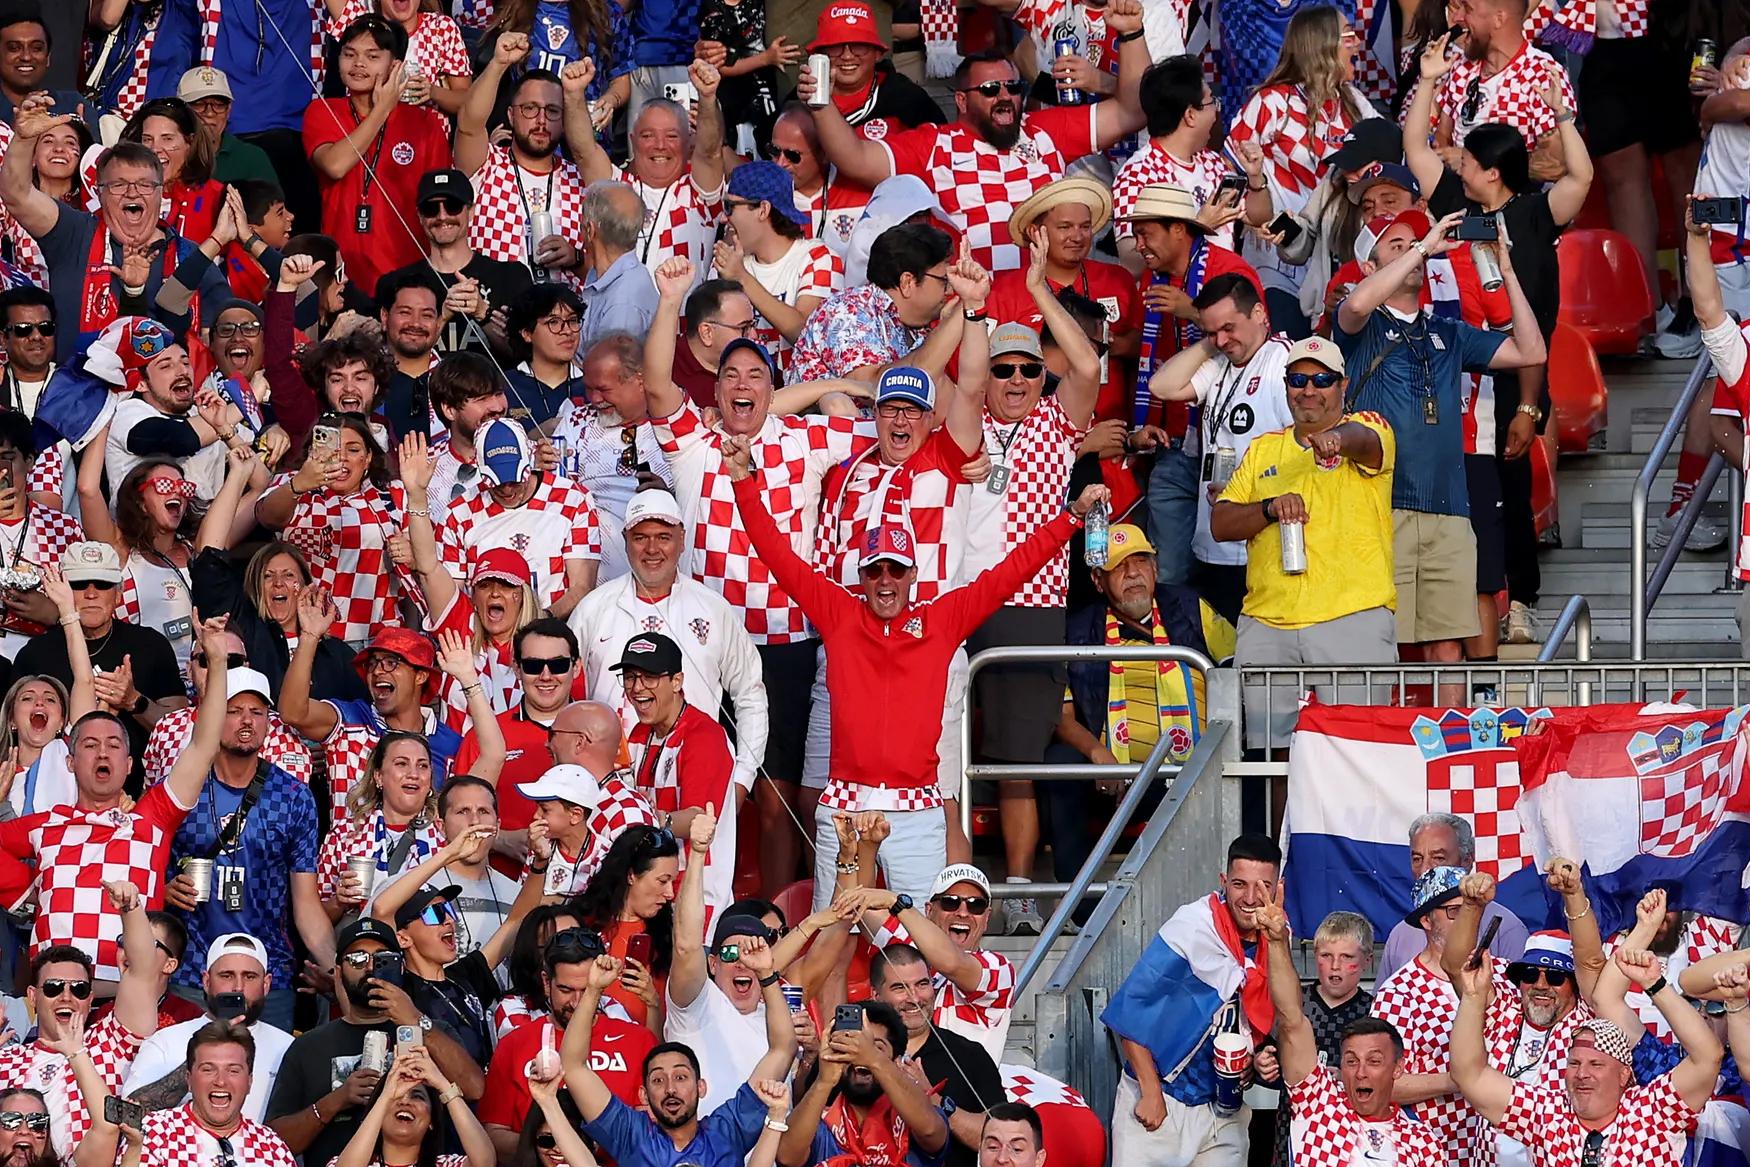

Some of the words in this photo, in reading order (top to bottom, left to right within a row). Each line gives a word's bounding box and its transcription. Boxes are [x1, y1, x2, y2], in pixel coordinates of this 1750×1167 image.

[831, 7, 869, 20] Canada
[886, 376, 922, 389] CROATIA
[941, 868, 988, 885] HRVATSKA
